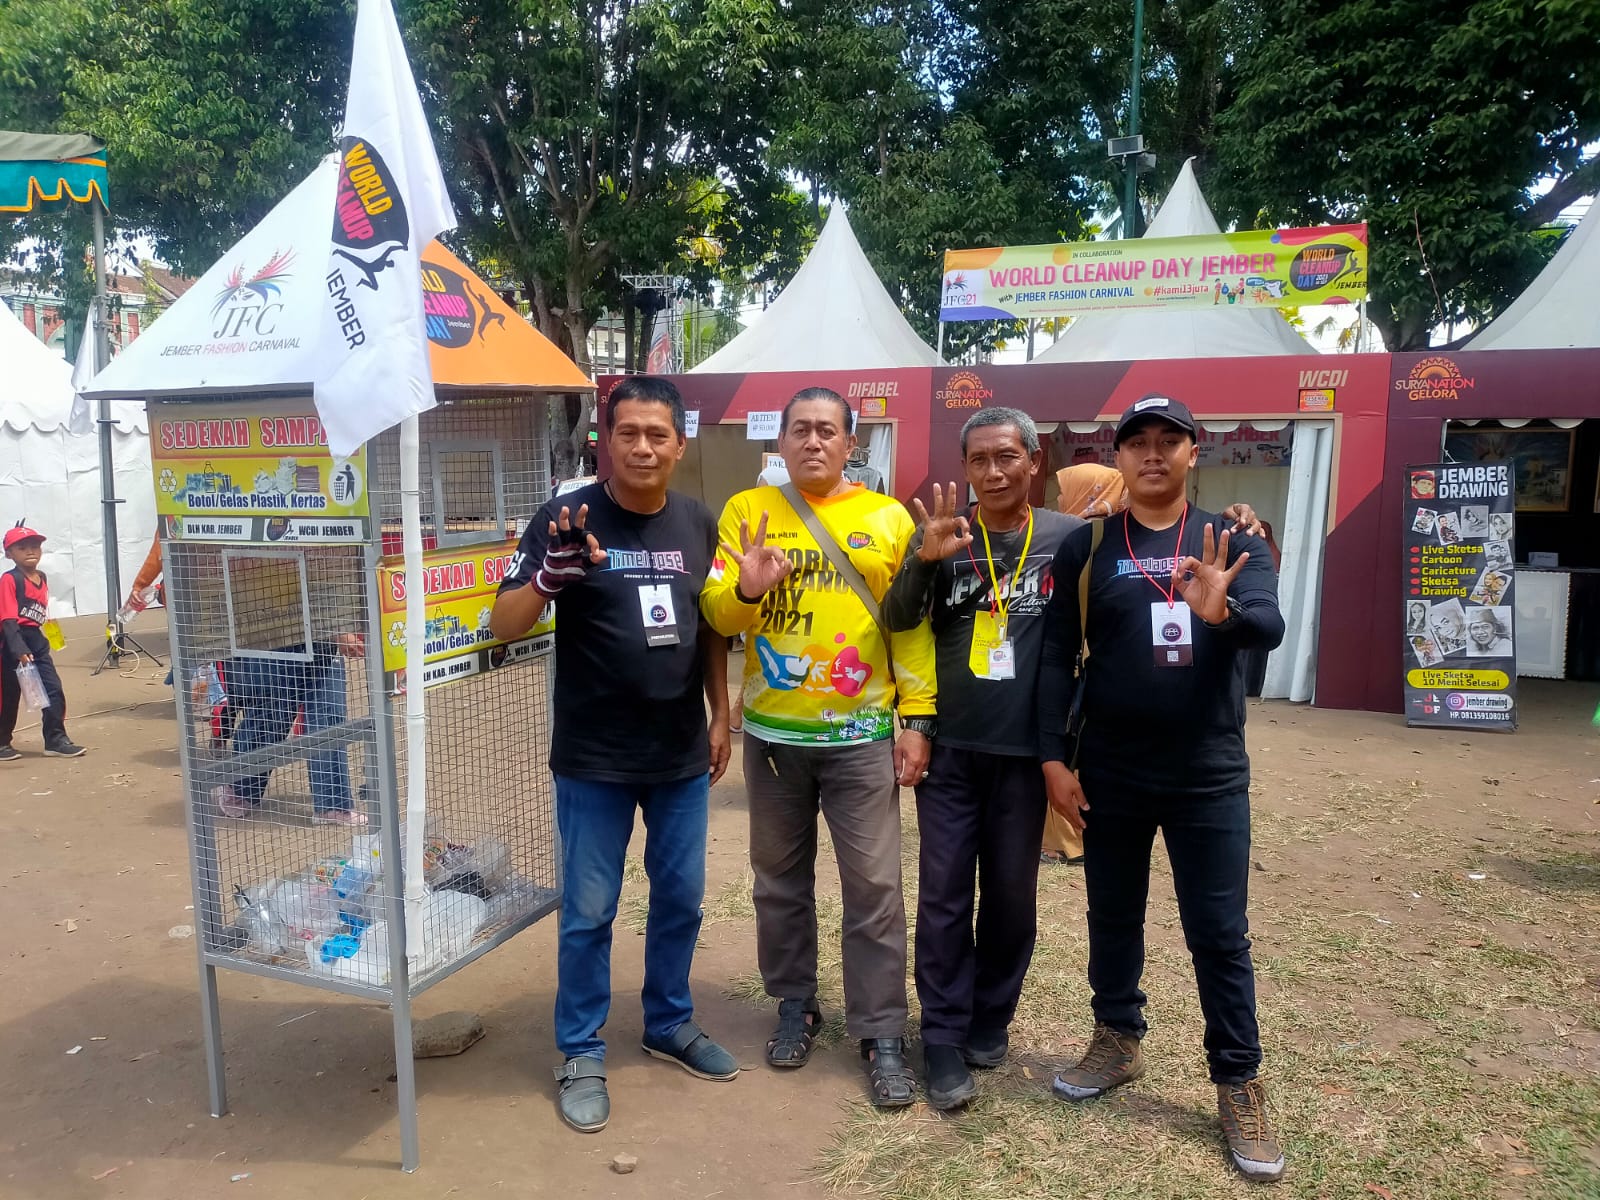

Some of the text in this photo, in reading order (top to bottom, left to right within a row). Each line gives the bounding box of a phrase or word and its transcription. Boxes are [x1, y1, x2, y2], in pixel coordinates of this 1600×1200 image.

[343, 142, 393, 216] WORLD
[1079, 250, 1123, 258] COLLABORATION
[1303, 248, 1335, 262] WORLD
[989, 252, 1276, 288] WORLD CLEANUP DAY JEMBER
[1300, 260, 1341, 275] CLEANUP
[1297, 275, 1317, 288] DAY
[1015, 291, 1046, 304] JEMBER
[1049, 288, 1088, 300] FASHION
[1089, 286, 1134, 299] CARNIVAL
[213, 303, 284, 339] JFC
[160, 337, 300, 357] JEMBER FASHION CARNAVAL
[1299, 369, 1348, 388] WCDI
[1395, 377, 1475, 390] SURYANATION
[848, 381, 899, 398] DIFABEL
[1408, 389, 1458, 401] GELORA
[945, 398, 982, 408] GELORA
[160, 418, 249, 449] SEDEKAH
[1439, 466, 1508, 483] JEMBER
[1439, 481, 1509, 499] DRAWING
[188, 493, 326, 509] Botol/Gelas Plastik, Kertas
[187, 524, 200, 535] DLH
[217, 524, 243, 535] JEMBER
[299, 525, 319, 536] WCDI
[322, 525, 354, 536] JEMBER
[1422, 545, 1484, 554] Live Sketsa
[1421, 556, 1462, 564] Cartoon
[1421, 567, 1477, 575] Caricature
[1421, 577, 1459, 586] Sketsa
[1421, 586, 1467, 597] Drawing
[760, 609, 814, 636] 2021
[423, 631, 475, 655] otol/Gelas
[449, 660, 471, 675] JEMBER
[1423, 671, 1474, 679] Live Sketsa
[1466, 679, 1500, 687] Selesai
